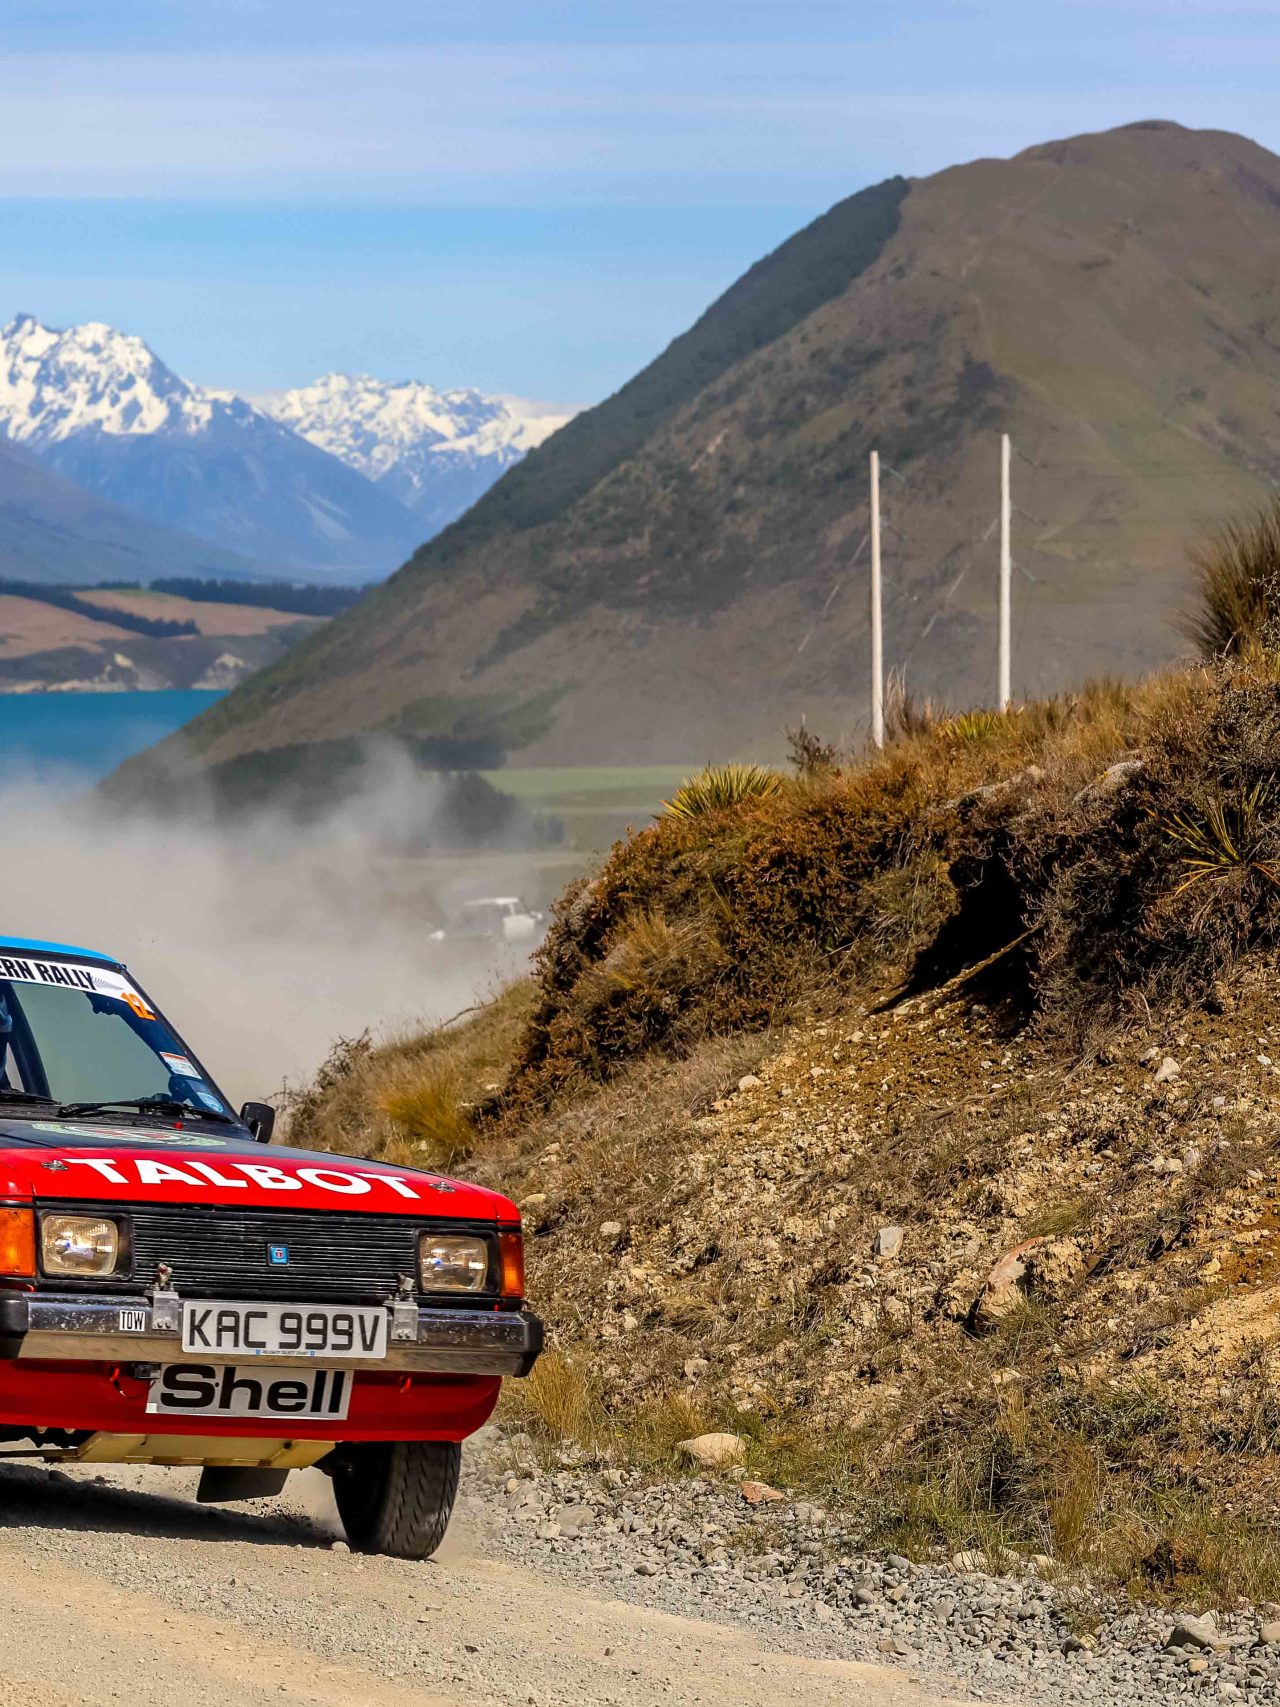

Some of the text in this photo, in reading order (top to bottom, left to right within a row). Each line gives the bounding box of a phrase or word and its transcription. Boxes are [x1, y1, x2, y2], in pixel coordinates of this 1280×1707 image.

[33, 963, 97, 991] RALLY
[121, 992, 157, 1020] 12
[63, 1158, 421, 1198] TALBOT
[121, 1311, 145, 1330] TOW
[189, 1309, 380, 1351] KAC 999V
[160, 1364, 345, 1413] Shell
